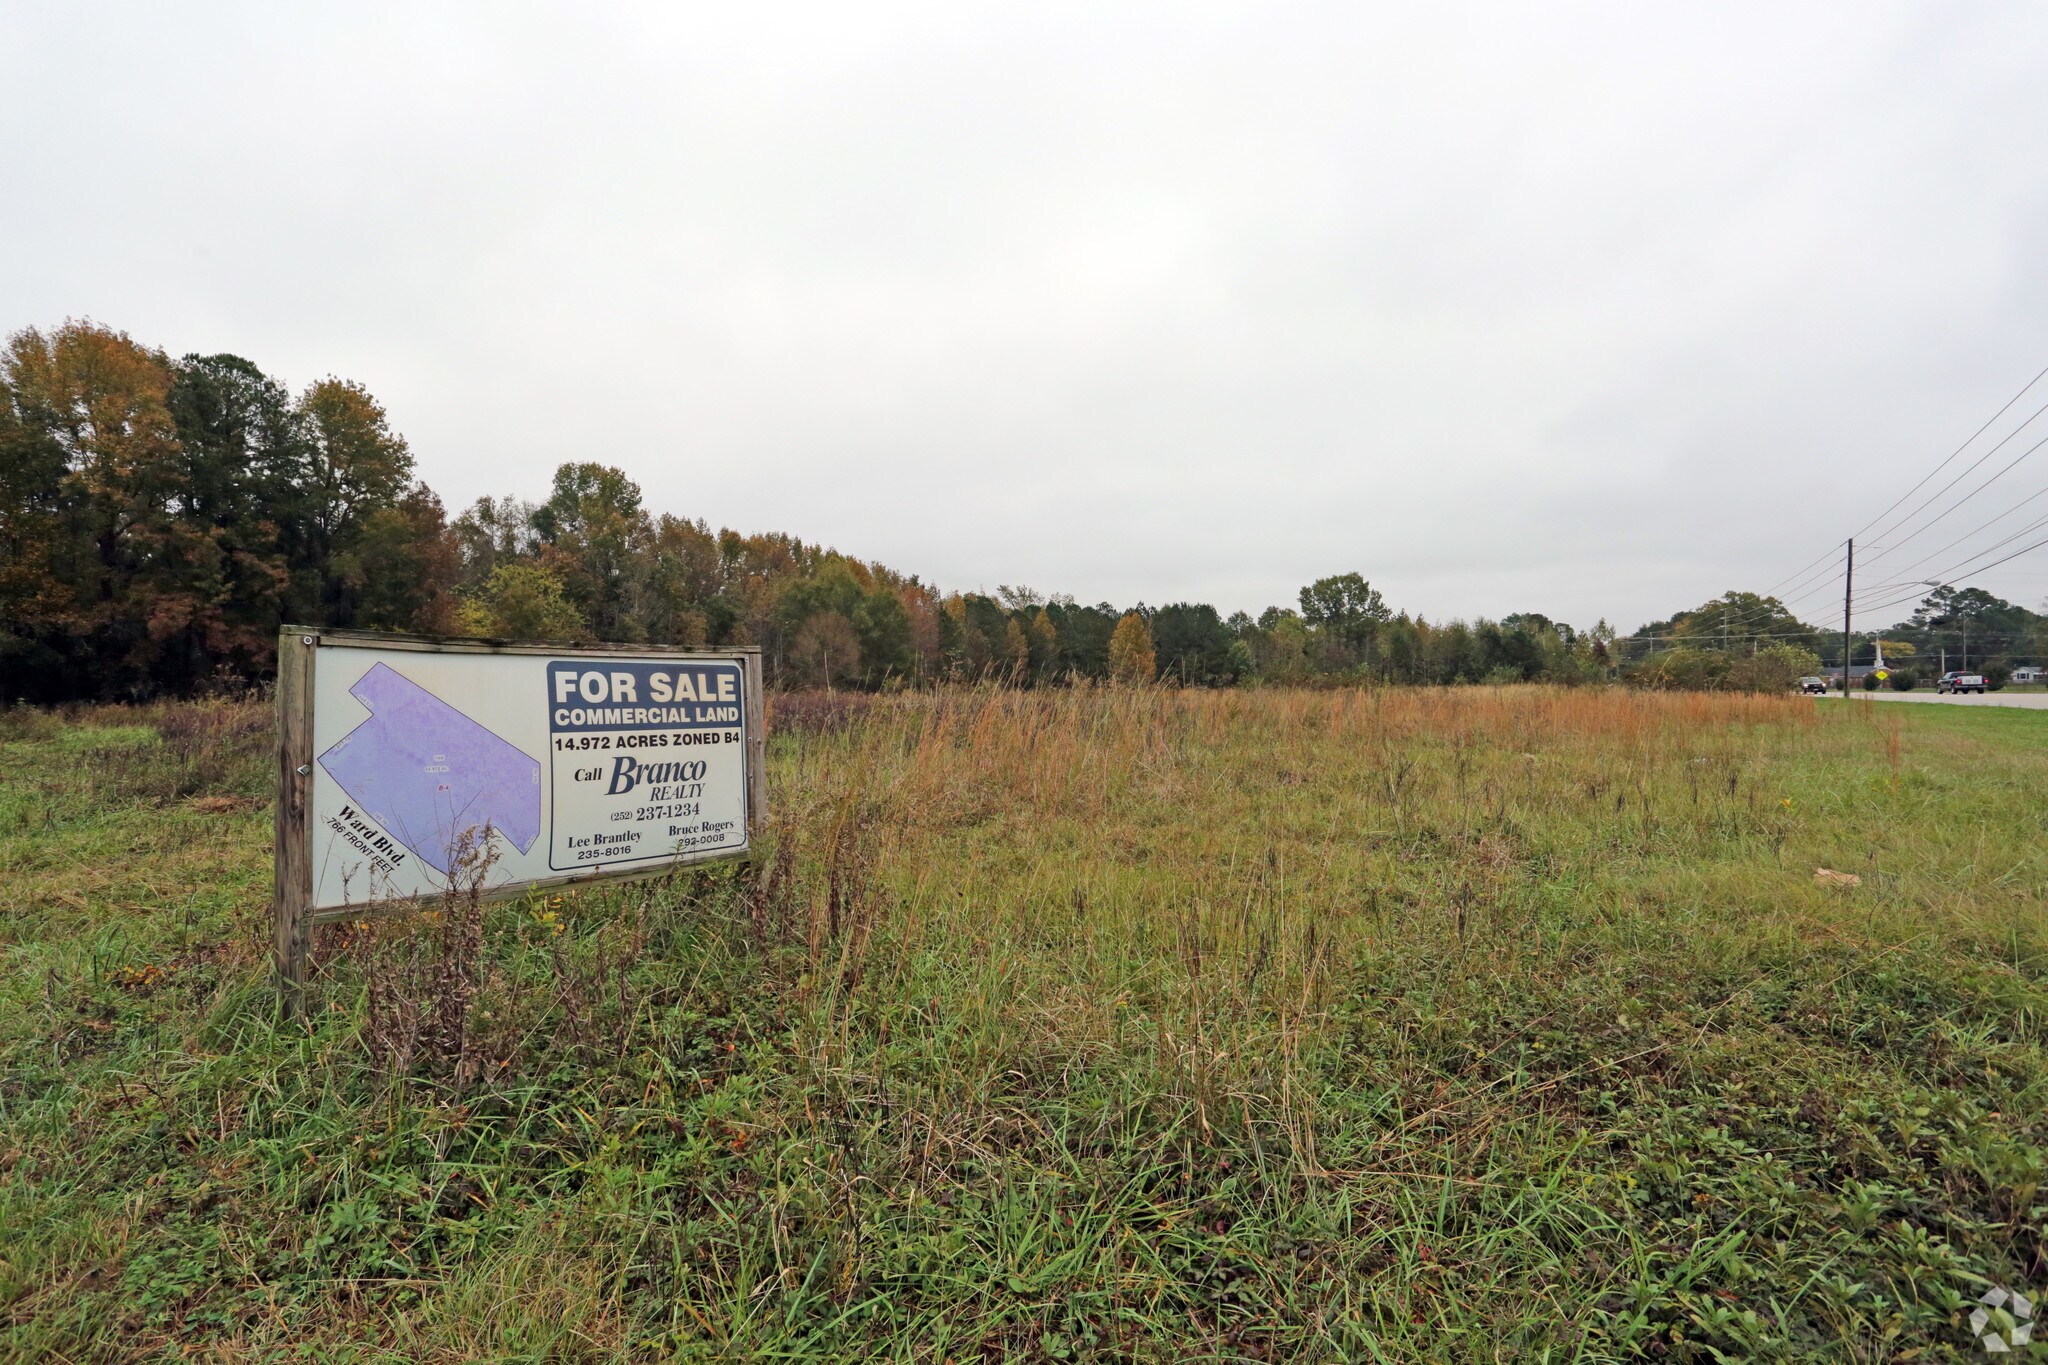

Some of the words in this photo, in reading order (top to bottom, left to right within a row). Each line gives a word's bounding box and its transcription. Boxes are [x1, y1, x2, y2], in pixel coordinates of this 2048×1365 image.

[555, 671, 638, 704] FOR
[649, 672, 737, 703] SALE
[554, 707, 691, 726] COMMERCIAL
[696, 706, 739, 722] LAND
[555, 736, 611, 751] 14.972
[615, 734, 668, 749] ACRES
[673, 732, 720, 746] ZONED
[724, 732, 740, 744] B4
[574, 767, 603, 782] Call
[603, 756, 707, 796] Branco
[649, 783, 706, 802] REALTY
[610, 811, 633, 823] (252)
[636, 802, 700, 822] 237-1234
[339, 805, 378, 841] Ward
[372, 836, 406, 867] Blvd.
[668, 825, 699, 836] Bruce
[701, 821, 734, 833] Rogers
[326, 817, 346, 833] 766
[343, 831, 375, 857] FRONT
[371, 855, 395, 874] FEET
[568, 836, 591, 849] Lee
[593, 830, 643, 846] Brantley
[577, 845, 632, 860] 235-8016
